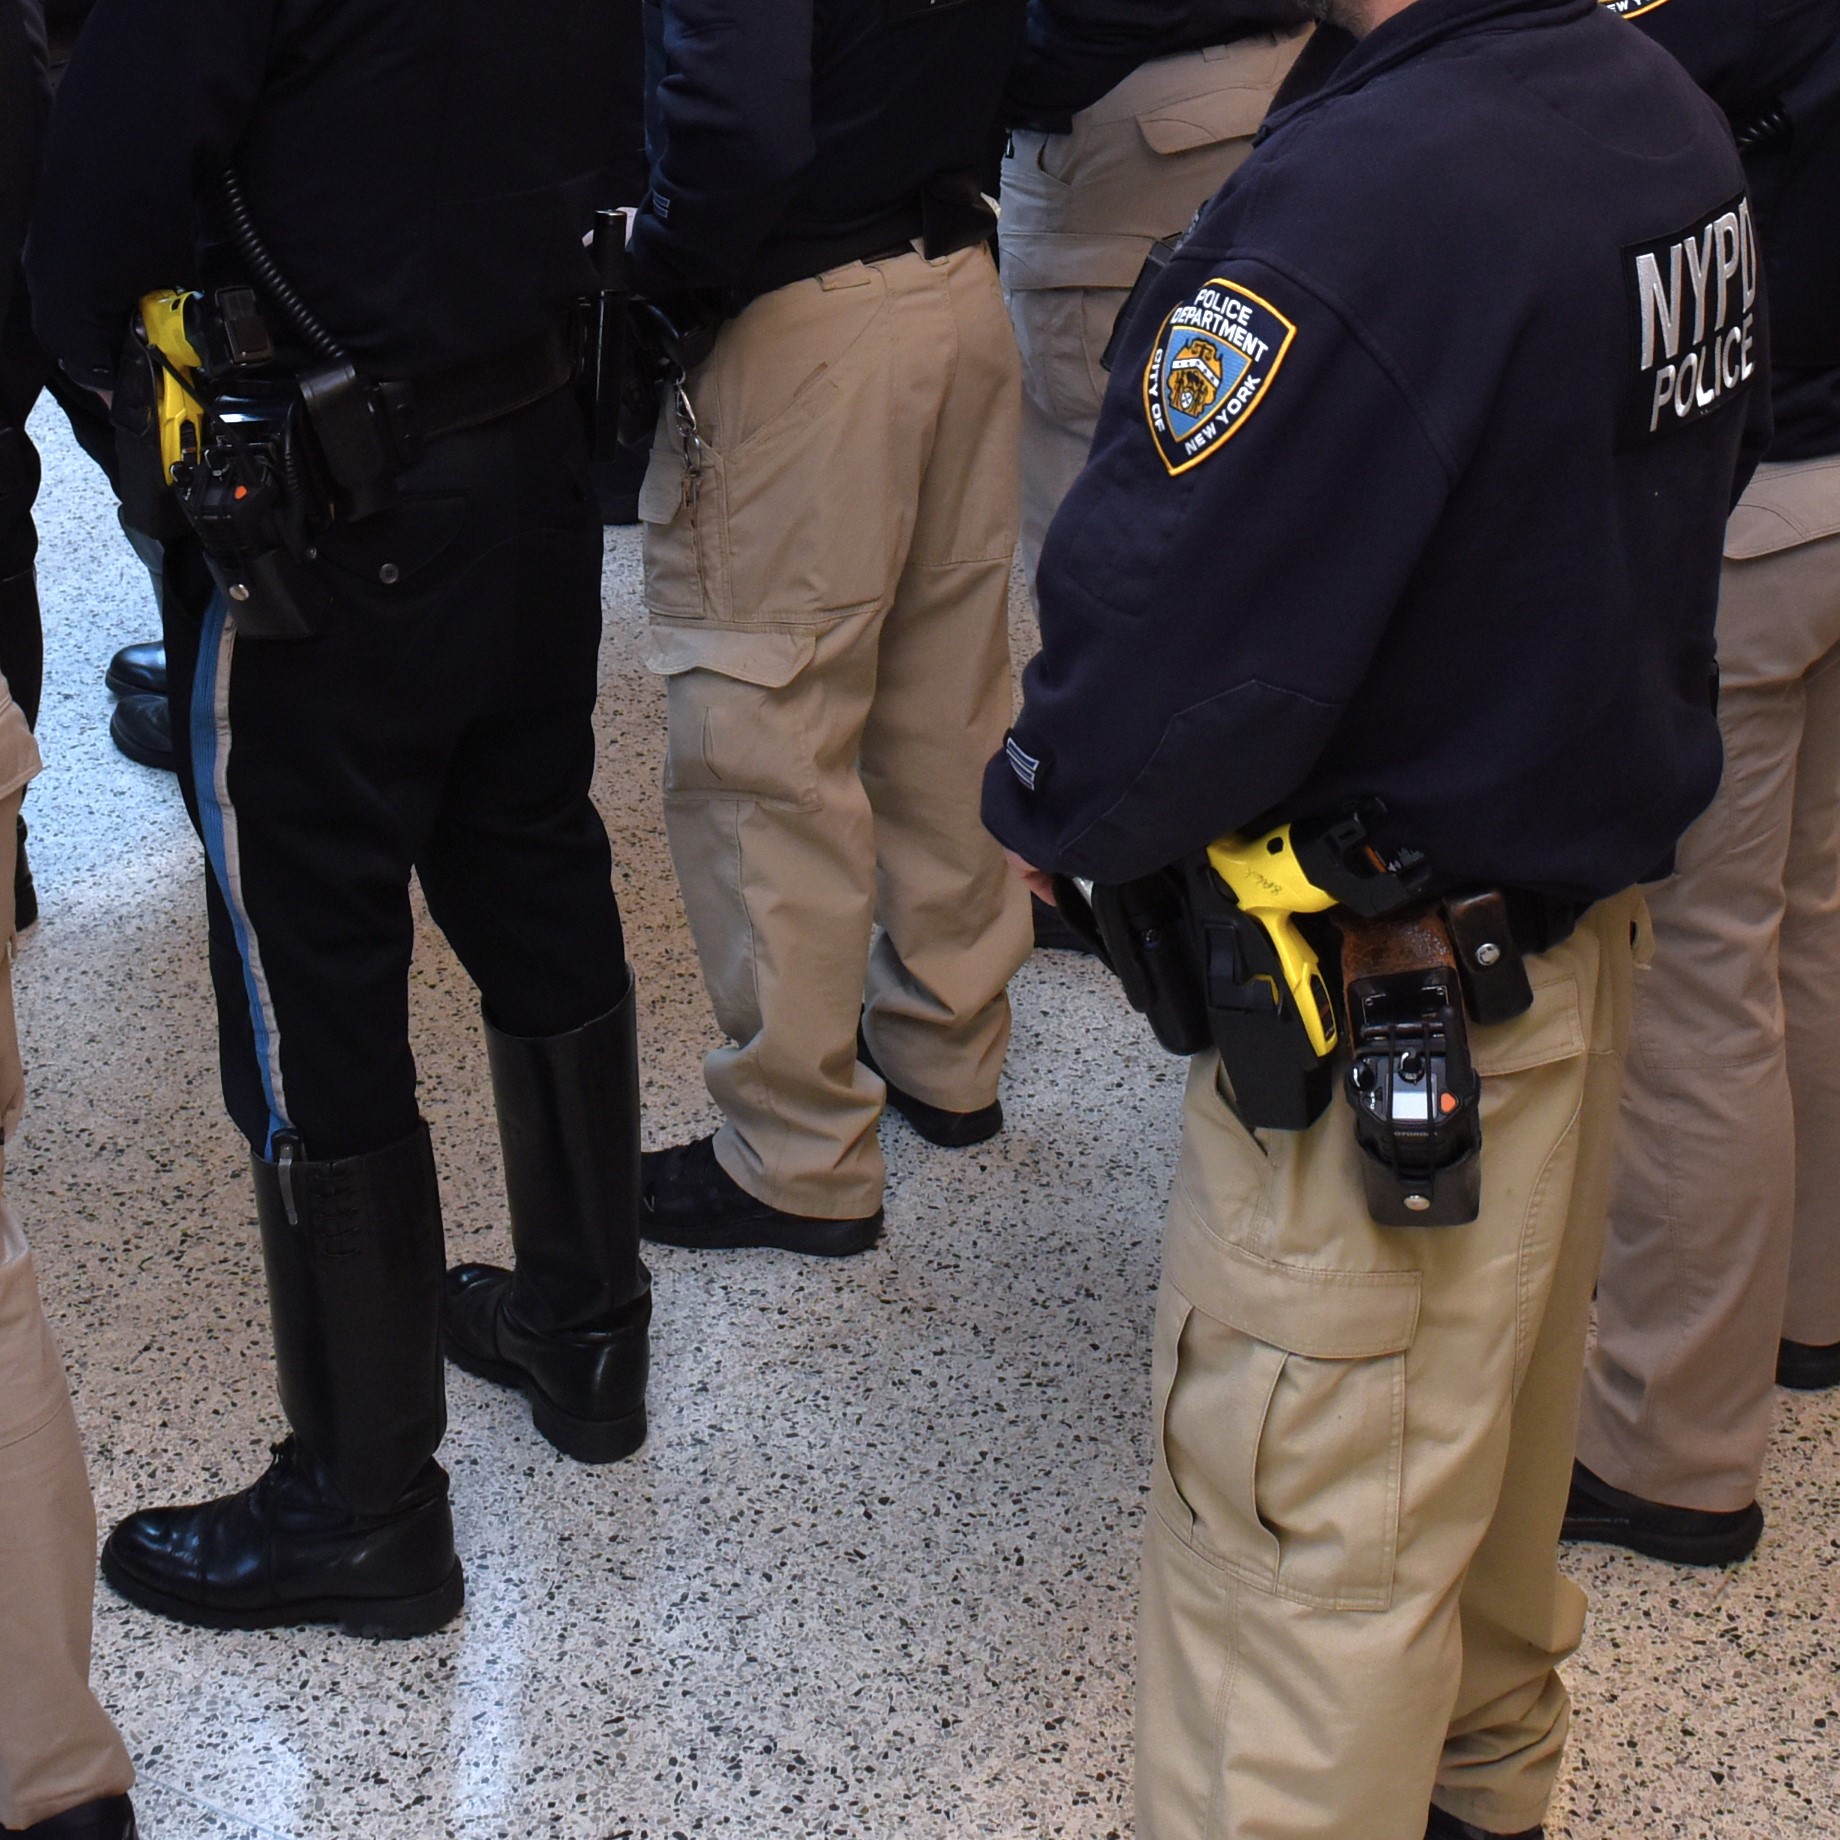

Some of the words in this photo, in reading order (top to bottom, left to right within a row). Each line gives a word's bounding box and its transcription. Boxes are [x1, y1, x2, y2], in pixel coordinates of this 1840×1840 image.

[1194, 288, 1252, 327] POLICE
[1635, 196, 1758, 371] NYPD
[1170, 305, 1268, 363] DEPARTMENT
[1148, 347, 1163, 397] CITY
[1649, 312, 1756, 433] POLICE
[1151, 403, 1166, 432] OF
[1184, 421, 1218, 456] NEW
[1216, 374, 1262, 426] YORK
